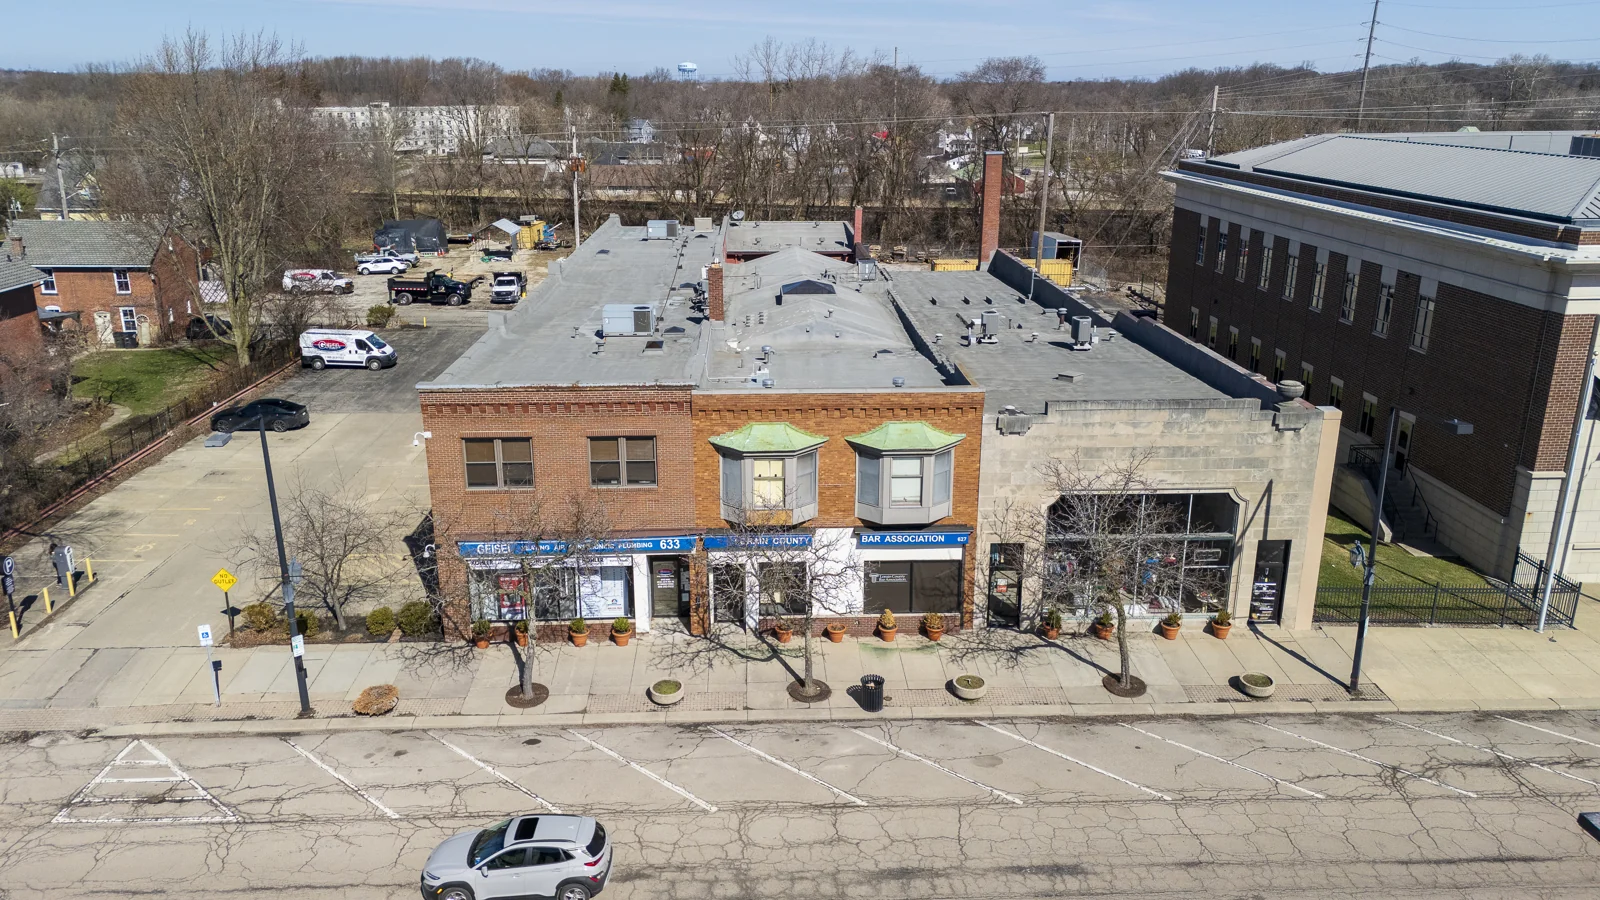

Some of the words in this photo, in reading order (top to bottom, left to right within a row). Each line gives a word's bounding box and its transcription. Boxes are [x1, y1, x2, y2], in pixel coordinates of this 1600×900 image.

[734, 537, 768, 545] ORAIN
[771, 537, 810, 545] COUNTY
[861, 535, 881, 543] BAR
[884, 534, 945, 543] ASSOCIATION
[617, 541, 653, 549] PLUMBING
[659, 539, 681, 549] 633
